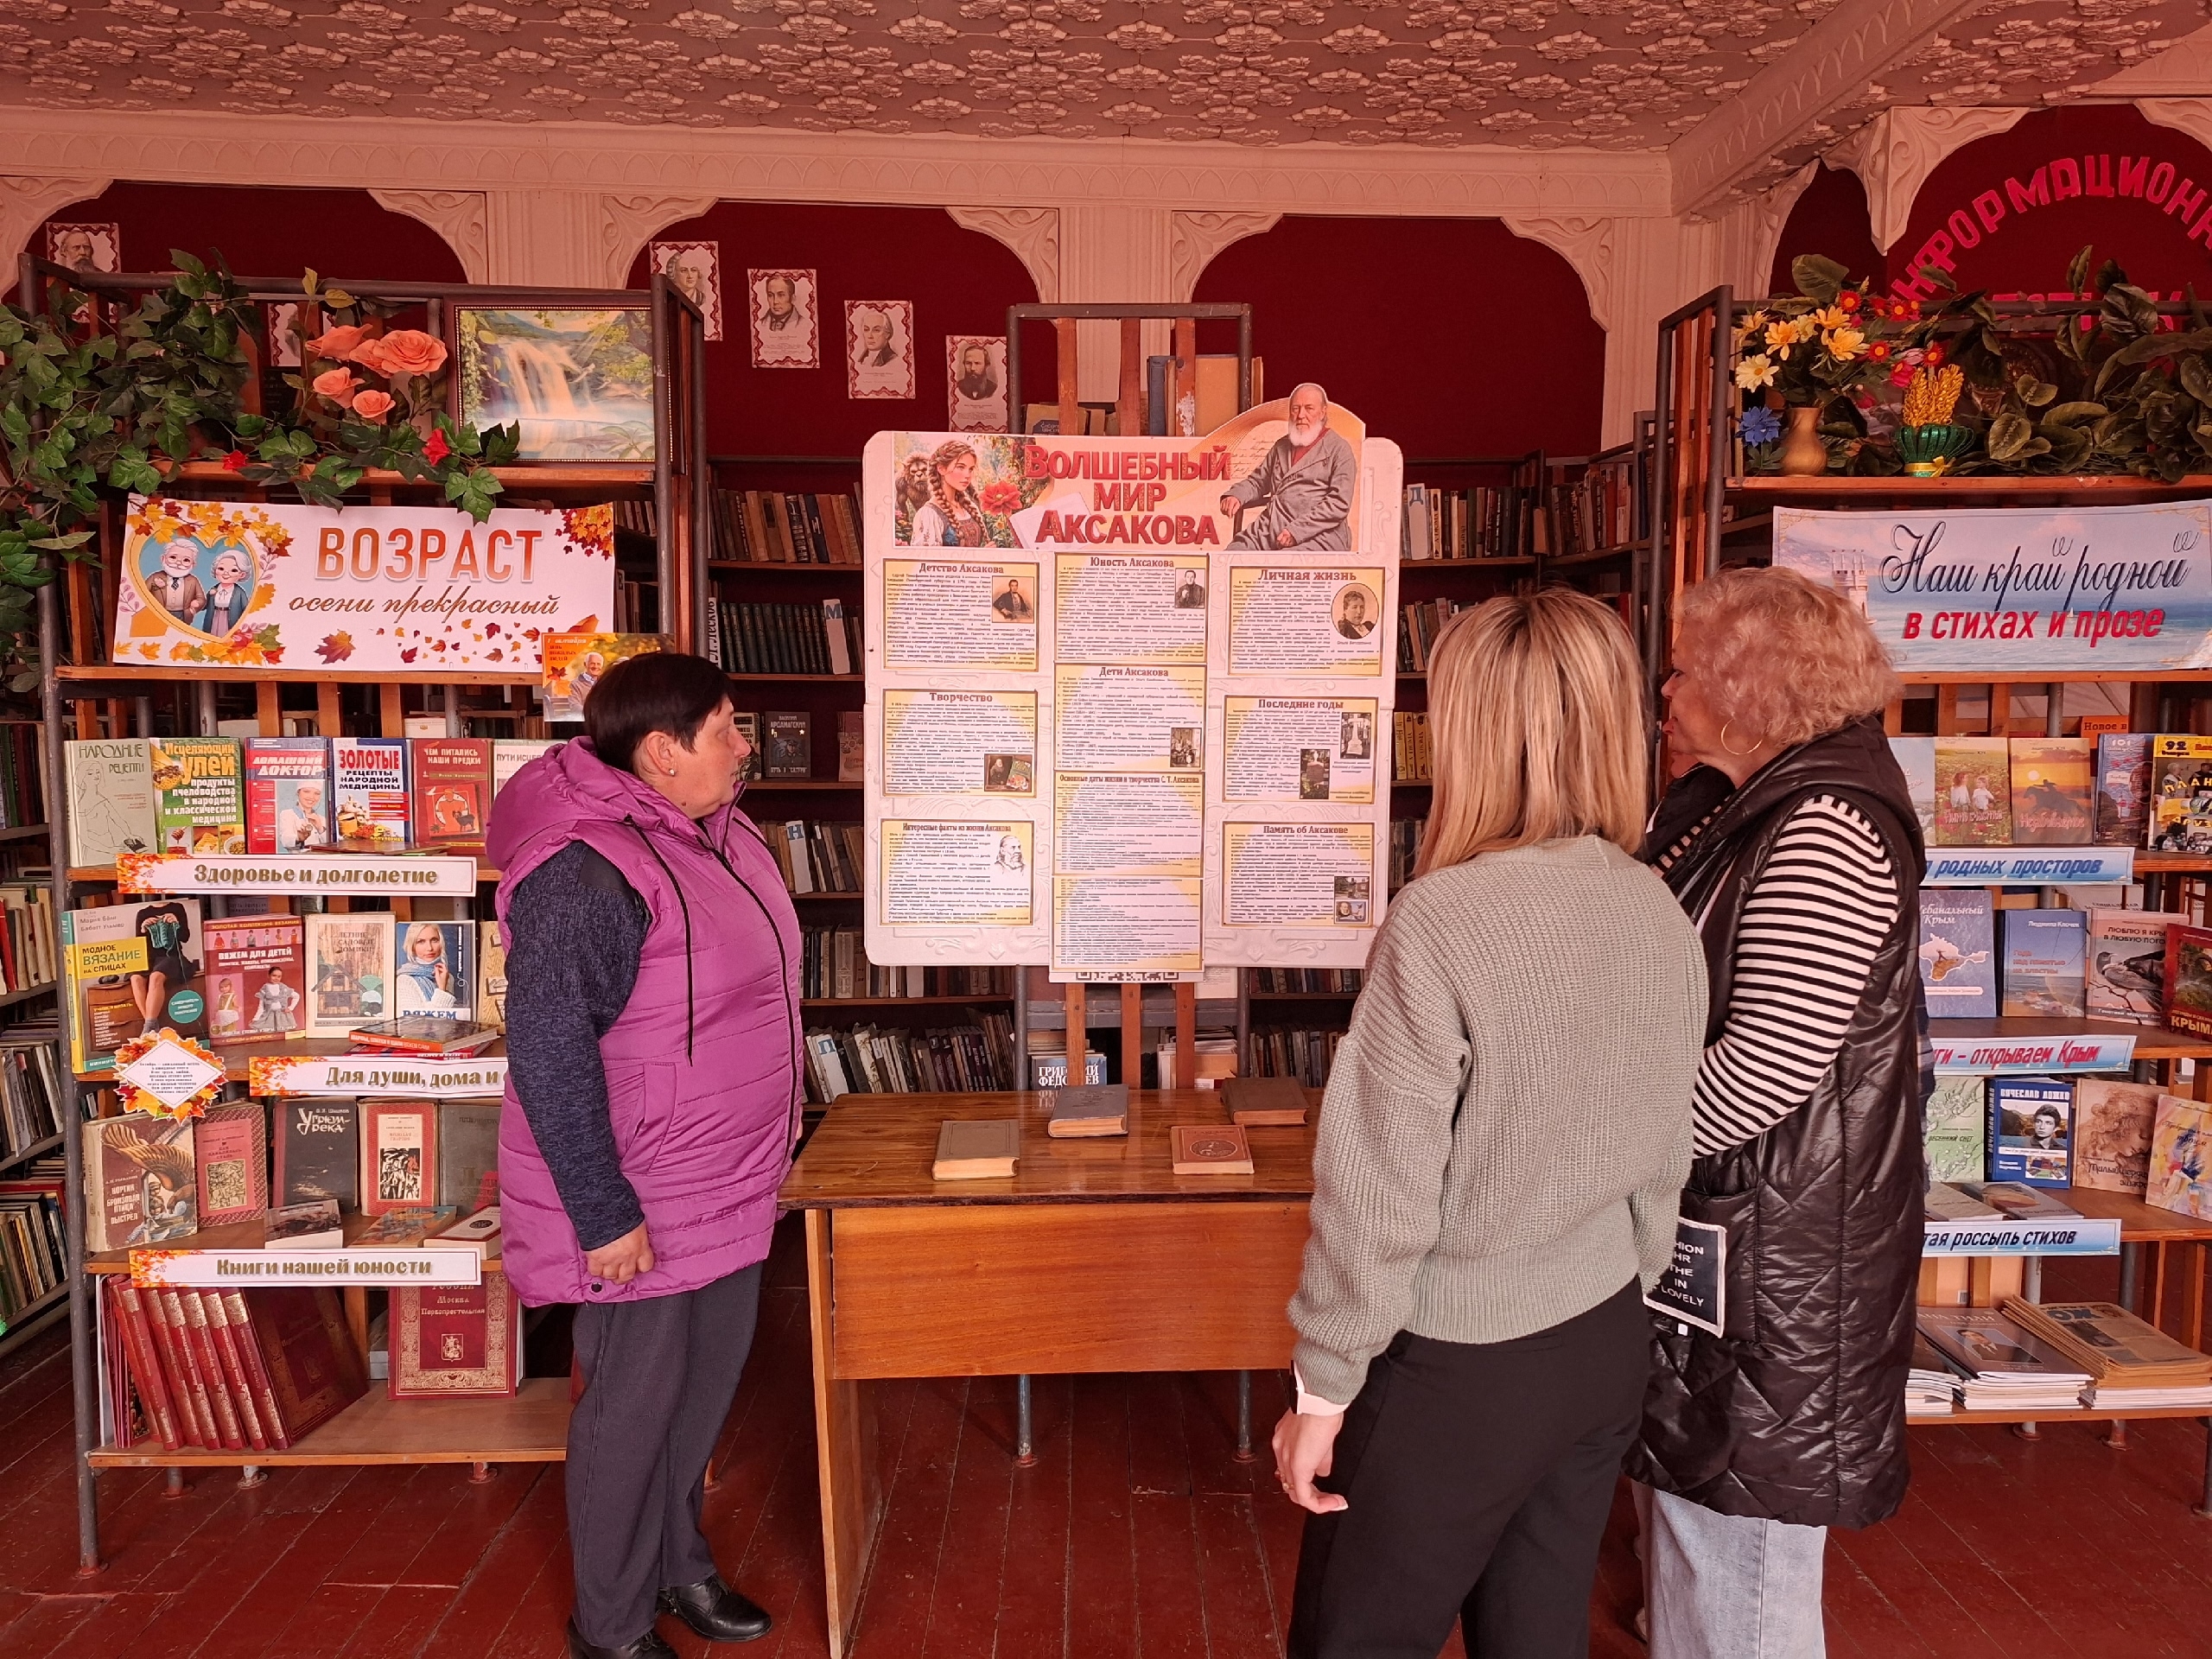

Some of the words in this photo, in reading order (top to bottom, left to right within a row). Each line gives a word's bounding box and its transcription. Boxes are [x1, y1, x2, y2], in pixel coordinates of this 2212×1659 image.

[1889, 155, 2212, 301] НФОРМАЦИОН
[1025, 445, 1231, 480] ВОЛШЕБНЫЙ
[1094, 482, 1166, 512] МИР
[1034, 510, 1220, 544] АКСАКОВА
[315, 527, 543, 582] ВОЗРАСТ
[1090, 557, 1127, 567] Юность
[1129, 558, 1174, 568] Аксакова
[1879, 521, 1978, 594] Наш
[1982, 537, 2073, 611] край
[2063, 530, 2199, 611] родной
[918, 563, 957, 573] Детство
[959, 564, 1004, 574] Аксакова
[1258, 569, 1310, 581] Личная
[1313, 571, 1357, 581] жизнь
[289, 596, 374, 614] осени
[382, 585, 561, 624] прекрасный
[1903, 613, 1923, 639] в
[1931, 610, 2038, 639] стихах
[2047, 610, 2066, 638] и
[2074, 608, 2165, 647] прозе
[1099, 667, 1122, 677] Дети
[1124, 668, 1168, 677] Аксакова
[929, 692, 993, 702] Творчество
[1258, 699, 1314, 709] Последние
[2165, 741, 2186, 750] 92
[441, 748, 478, 757] ПИТАЛИСЬ
[252, 756, 323, 765] ДОМАШНИЙ
[340, 749, 400, 770] ЗОЛОТЫЕ
[428, 756, 449, 765] НАШИ
[453, 757, 481, 766] ПРЕДКИ
[181, 753, 235, 785] улей
[257, 766, 323, 776] ДОКТОР
[191, 779, 235, 789] продукты
[1059, 774, 1088, 783] Основные
[173, 787, 236, 797] пчеловодства
[192, 796, 236, 806] народной
[174, 805, 237, 816] классической
[192, 815, 237, 825] медицине
[903, 823, 938, 831] Интересные
[939, 823, 957, 832] факты
[194, 864, 294, 885] Здоровье
[299, 869, 312, 882] и
[316, 869, 437, 885] долголетие
[1935, 860, 2006, 878] родных
[2011, 860, 2104, 878] просторов
[1923, 915, 1955, 927] Крым
[2108, 926, 2139, 935] ЛЮБЛЮ
[2110, 935, 2142, 944] ЛЮБУЮ
[82, 944, 116, 955] МОДНОЕ
[219, 950, 248, 960] ВЯЖЕМ
[250, 950, 266, 959] ДЛЯ
[268, 947, 292, 957] ДЕТЕЙ
[83, 950, 141, 965] ВЯЗАНИЕ
[93, 963, 126, 972] СПИЦАХ
[2171, 1016, 2212, 1035] КРЫМ
[1970, 1046, 2054, 1071] открываем
[2057, 1039, 2102, 1068] Крым
[1039, 1064, 1099, 1077] ГРИГИЙ
[326, 1067, 364, 1085] Для
[368, 1071, 426, 1088] души,
[429, 1071, 480, 1087] дома
[485, 1071, 499, 1084] и
[2000, 1089, 2039, 1099] ВЯЧЕСЛАВ
[2042, 1090, 2070, 1100] ЛОЖКО
[312, 1124, 346, 1133] река
[111, 1184, 135, 1194] КОРТИК
[107, 1193, 140, 1207] БРОНЗОВАЯ
[114, 1203, 134, 1213] ПТИЦА
[111, 1212, 138, 1224] ВЫСТРЕЛ
[1924, 1232, 1947, 1246] тая
[1951, 1231, 2019, 1250] россыпь
[2023, 1230, 2076, 1245] стихов
[216, 1258, 278, 1276] Книги
[282, 1257, 350, 1275] нашей
[353, 1259, 432, 1275] юности
[1669, 1264, 1694, 1276] THE
[1675, 1279, 1688, 1289] IN
[1661, 1285, 1704, 1307] LOVELY
